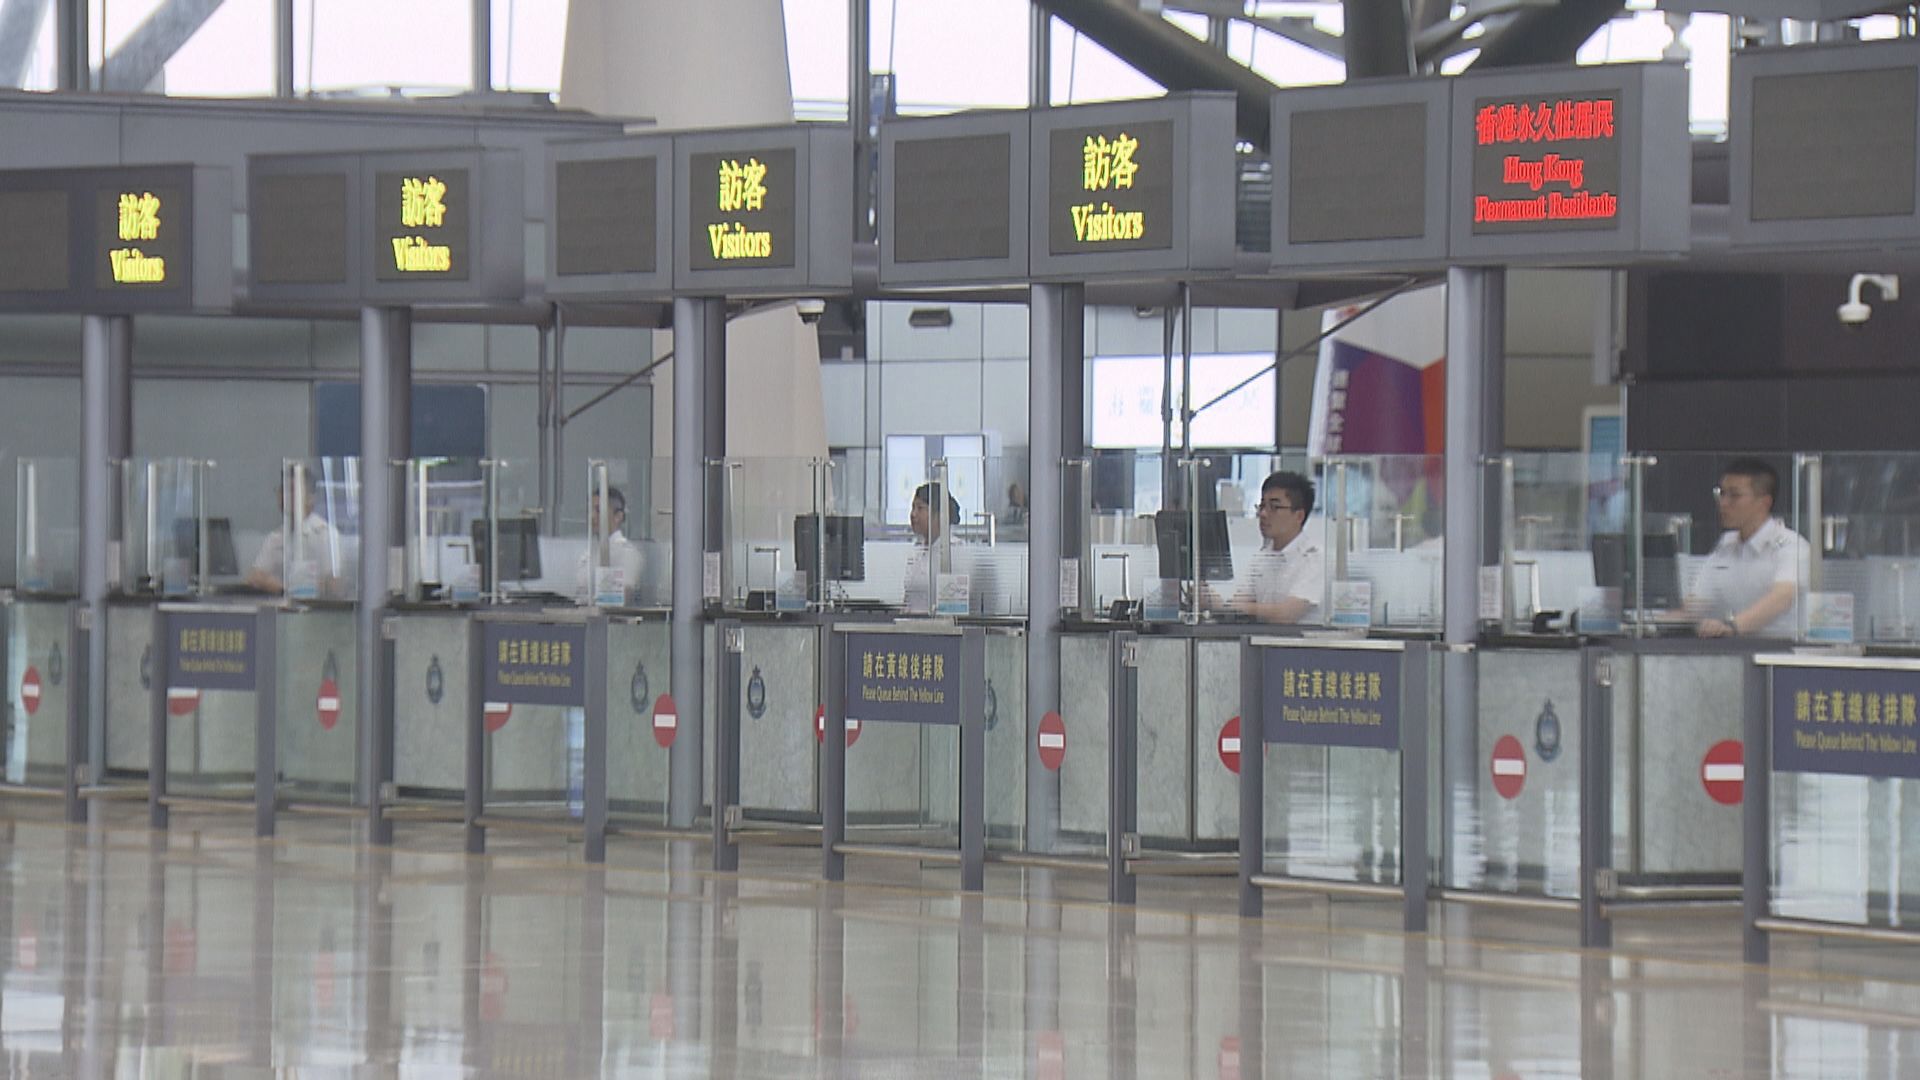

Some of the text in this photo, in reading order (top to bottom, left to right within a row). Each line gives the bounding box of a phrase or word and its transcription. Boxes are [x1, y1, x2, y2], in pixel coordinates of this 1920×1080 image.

[1476, 100, 1614, 145] 香港永久性居民
[1083, 133, 1138, 191] 訪客
[1503, 153, 1584, 191] Hong Kong
[402, 176, 446, 227] 訪客
[719, 158, 767, 211] 訪客
[119, 192, 161, 240] 訪客
[1071, 202, 1143, 241] Visitors
[1475, 191, 1617, 222] Permanent Residents
[392, 236, 451, 271] Visitors
[708, 222, 771, 259] Visitors
[110, 248, 164, 283] Visitors
[863, 684, 944, 704] Please Queue Behind The Yellow Line
